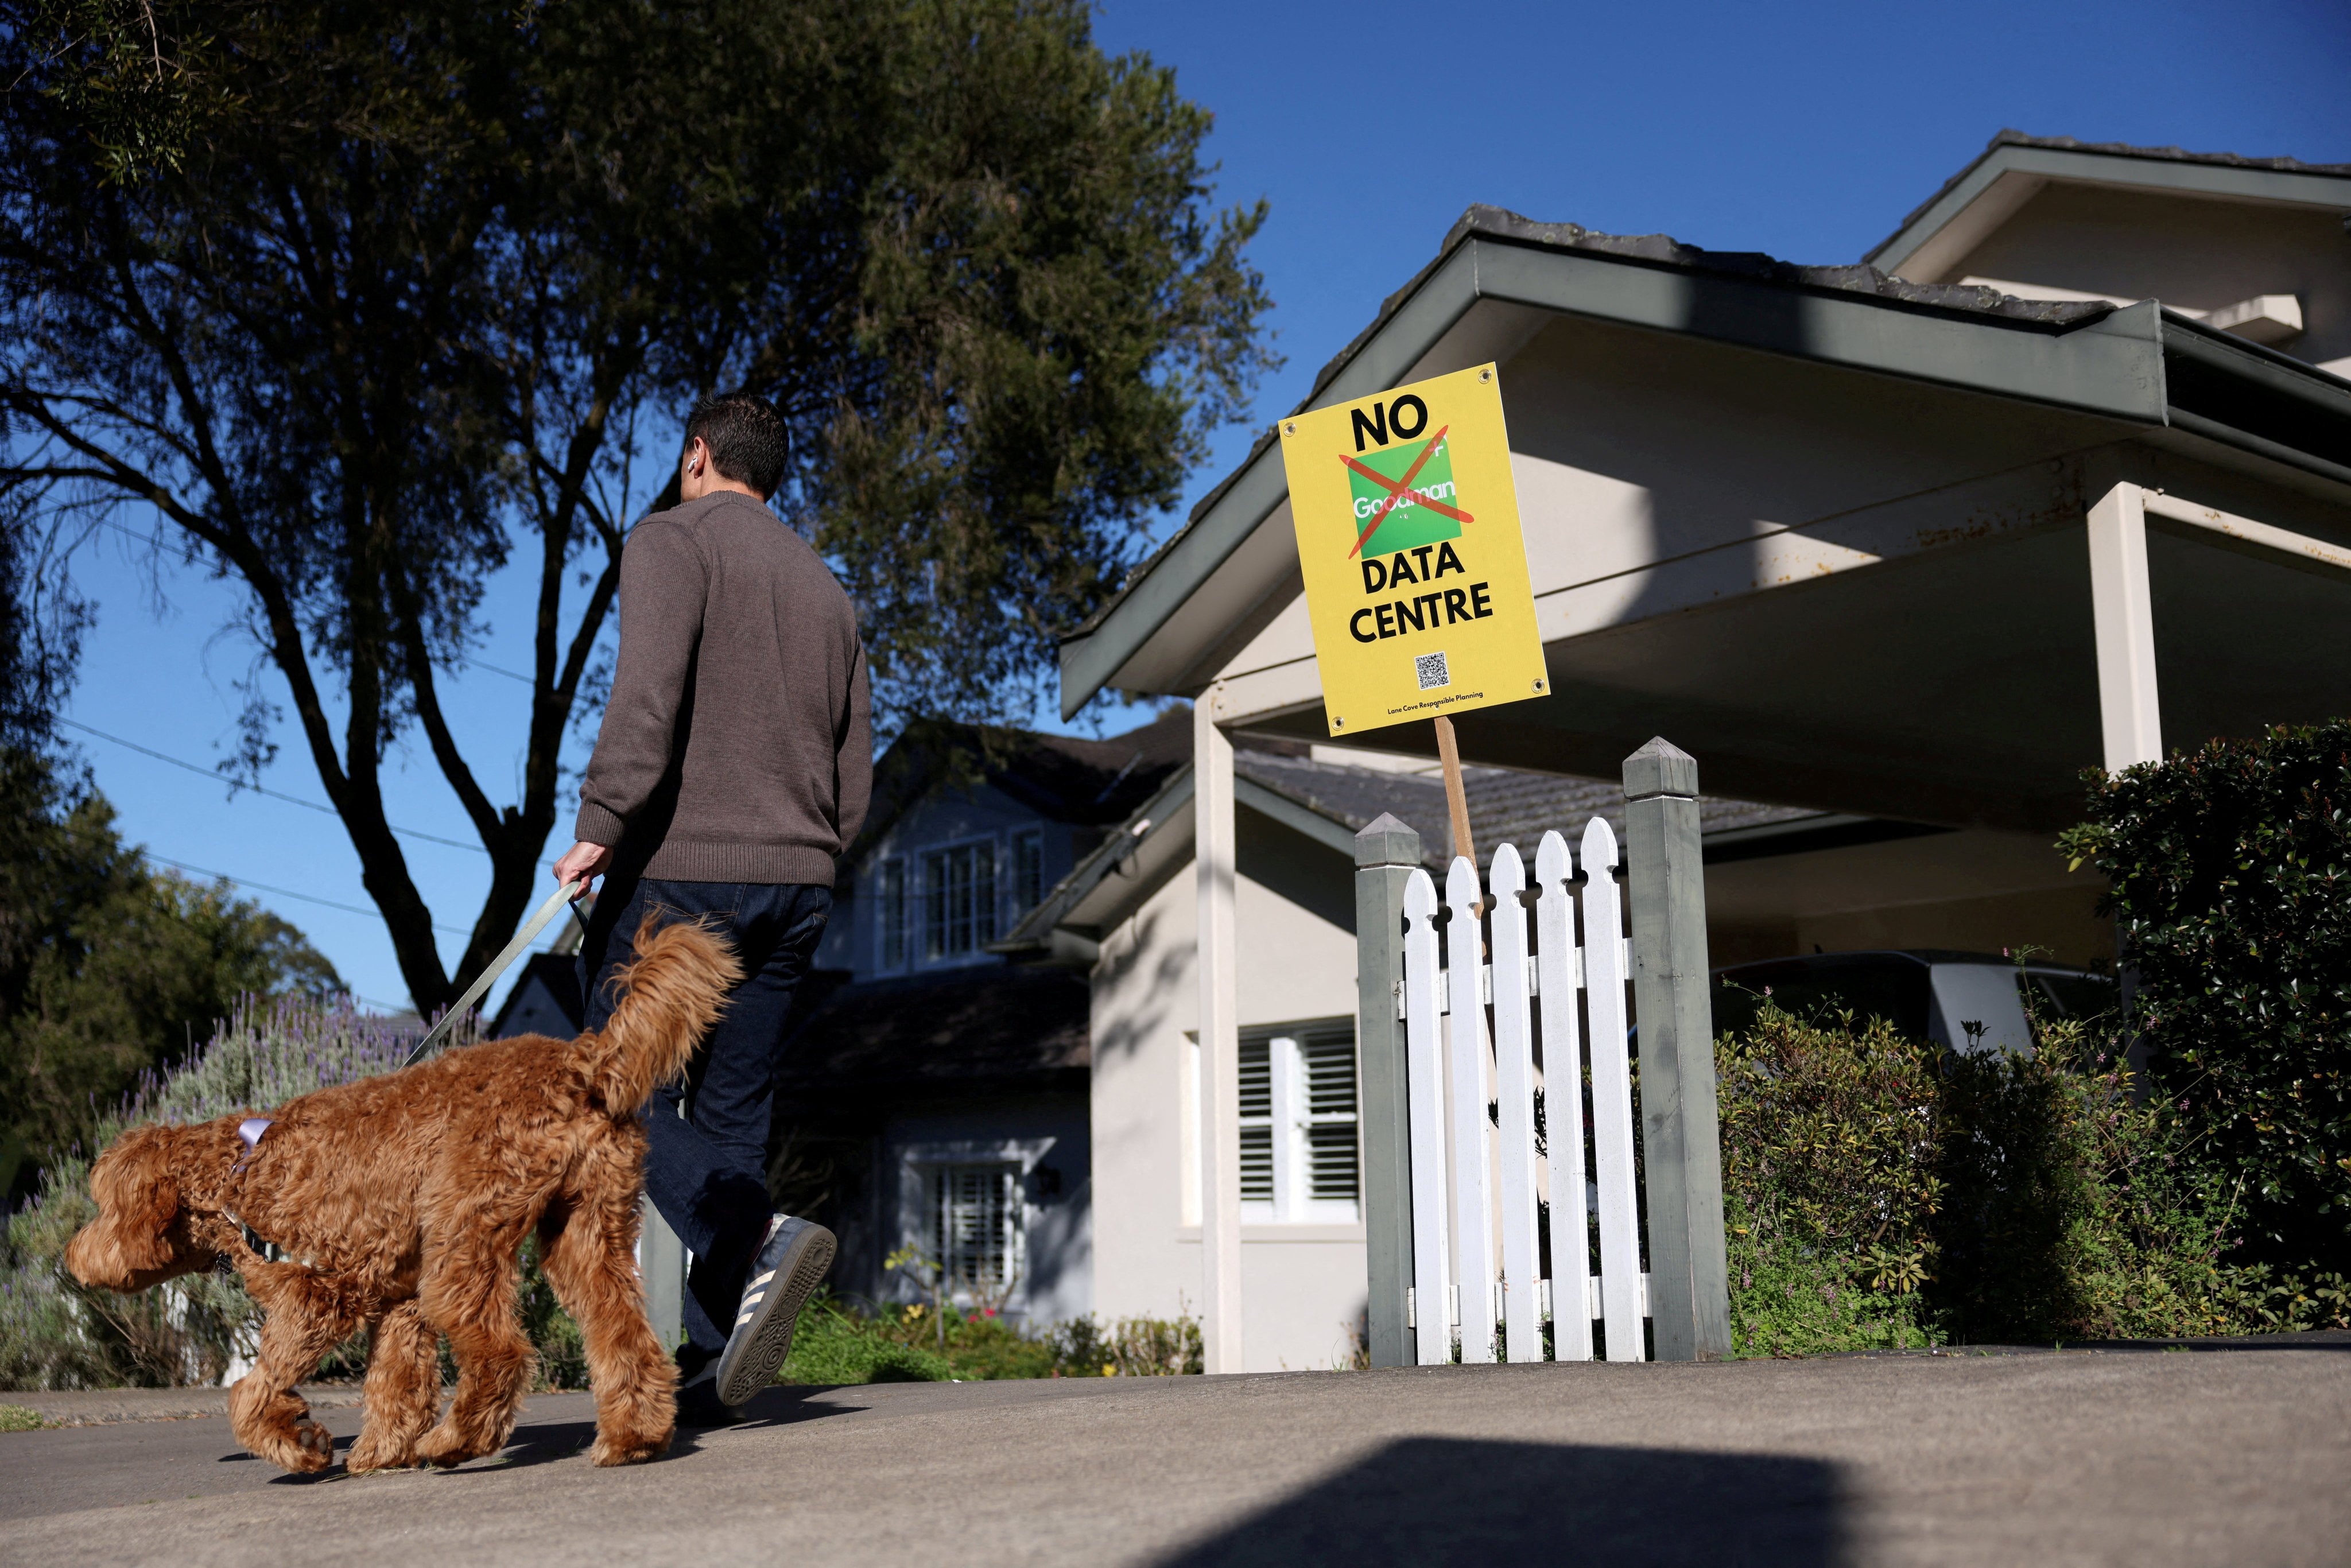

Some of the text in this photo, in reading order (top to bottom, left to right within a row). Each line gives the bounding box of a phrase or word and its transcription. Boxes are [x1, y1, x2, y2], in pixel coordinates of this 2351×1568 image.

[1351, 394, 1428, 452] NO
[1353, 481, 1456, 518] Goodman
[1361, 542, 1465, 594] DATA
[1350, 582, 1493, 643] CENTRE
[1419, 697, 1455, 709] Responsible
[1456, 692, 1483, 701] Planning
